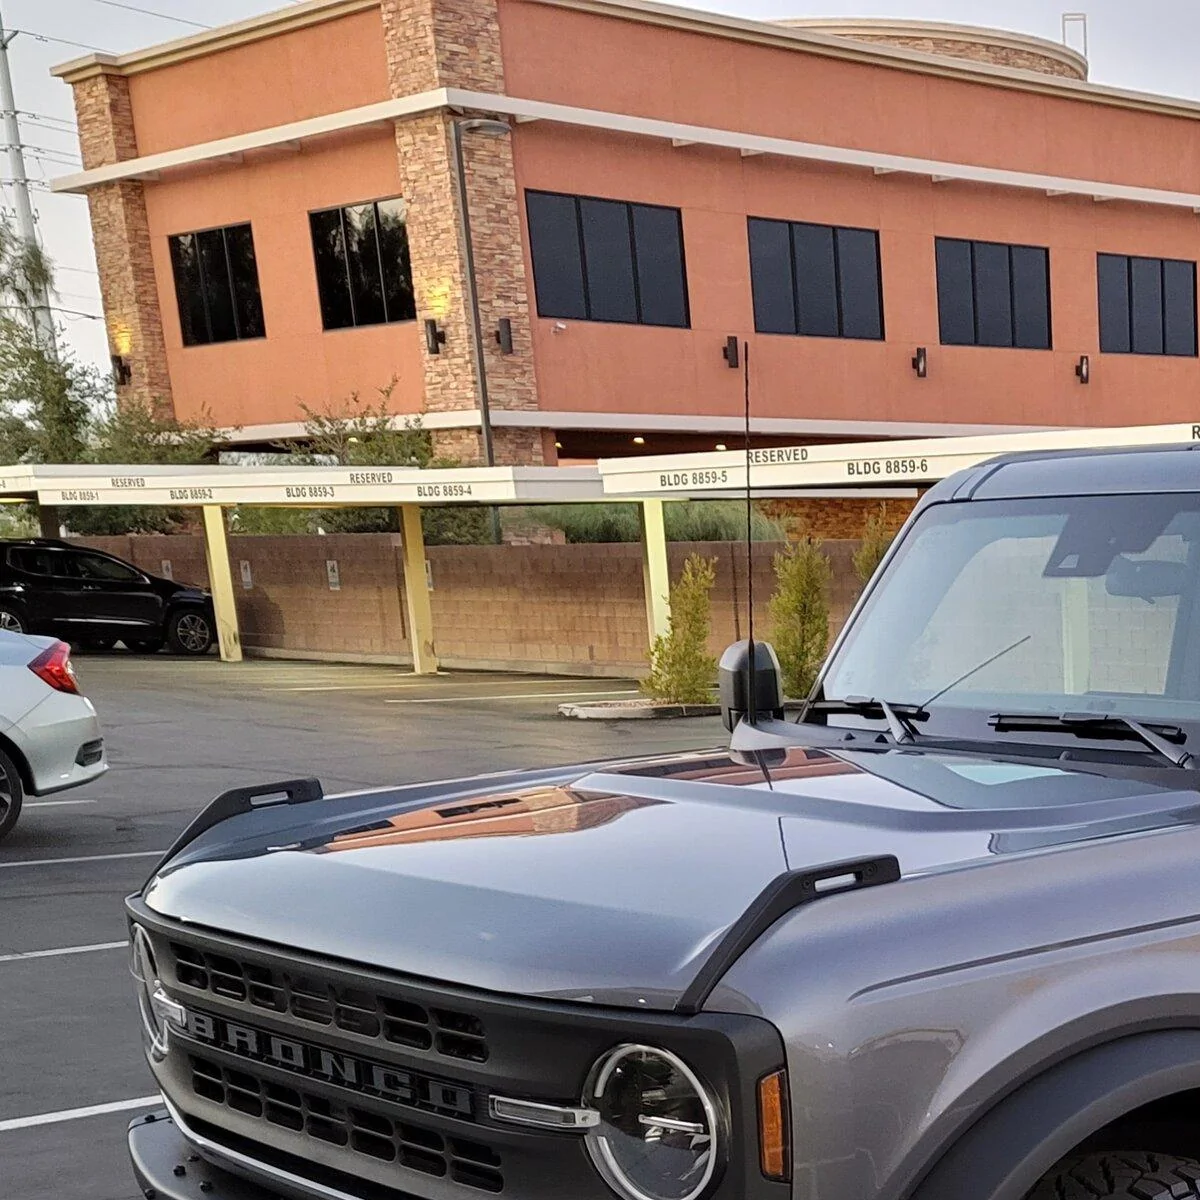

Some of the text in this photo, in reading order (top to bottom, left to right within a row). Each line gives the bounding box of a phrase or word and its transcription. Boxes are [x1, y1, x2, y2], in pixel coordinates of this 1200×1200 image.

[747, 448, 808, 463] RESERVED
[847, 459, 928, 475] BLDG 8859-6
[111, 478, 145, 488] RESERVED
[350, 472, 393, 484] RESERVED
[660, 470, 728, 487] BLDG 8859-5
[61, 491, 99, 501] BLDG 8859-1
[169, 488, 213, 500] BLDG 8859-2
[285, 486, 335, 498] BLDG 8859-3
[417, 485, 472, 497] BLDG 8859-4
[186, 1011, 474, 1116] BRONCO
